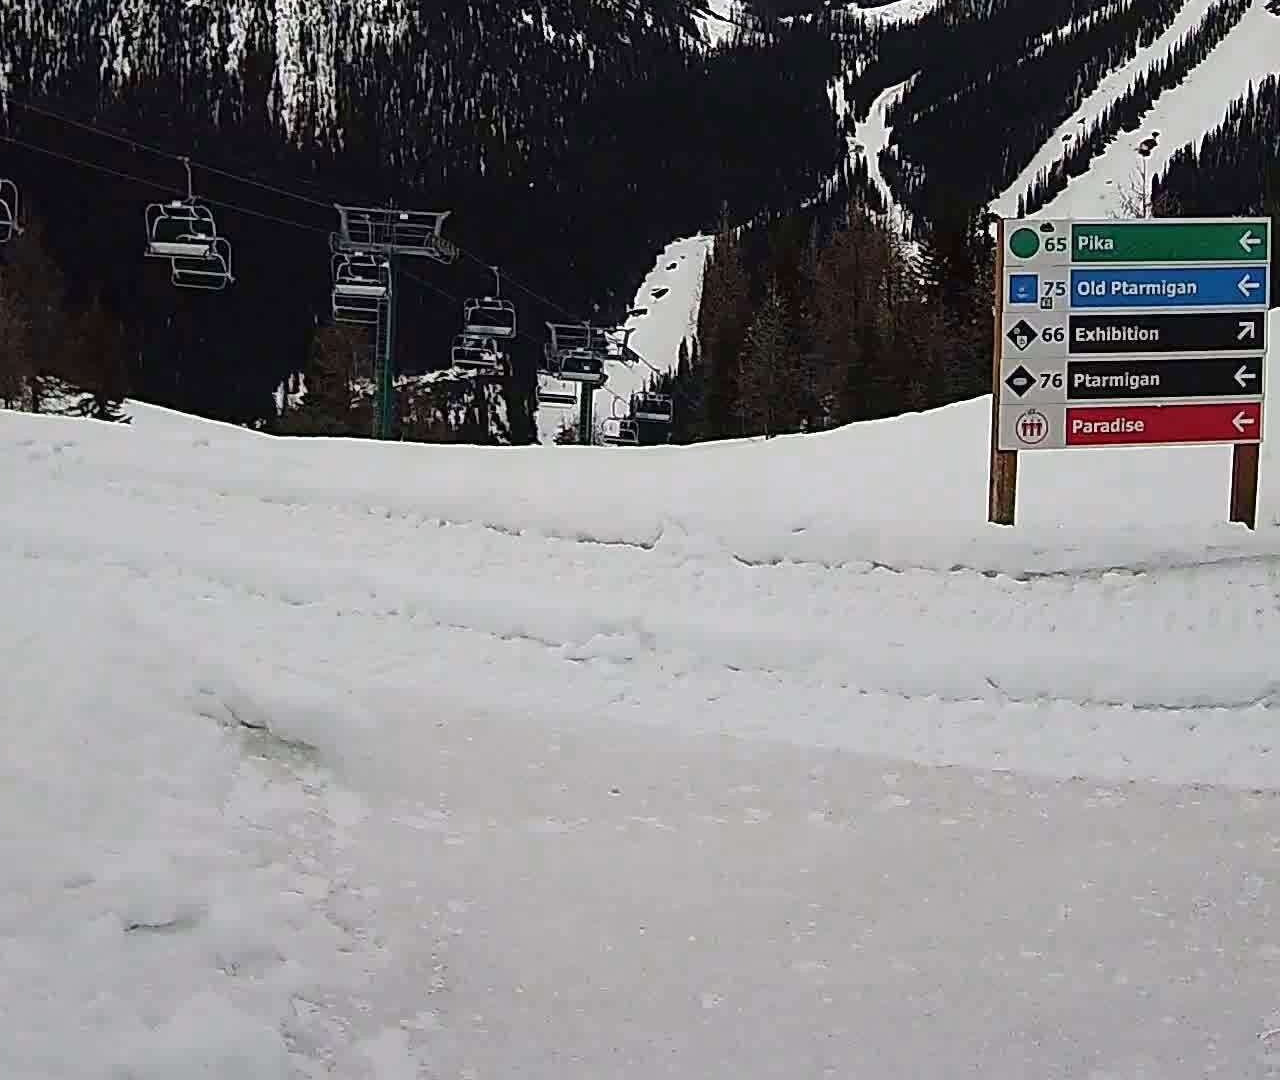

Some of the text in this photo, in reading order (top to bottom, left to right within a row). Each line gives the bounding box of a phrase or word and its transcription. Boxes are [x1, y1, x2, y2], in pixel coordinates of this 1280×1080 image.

[1044, 235, 1114, 253] 65 Pika
[1043, 280, 1198, 297] 75 Old Ptarmigan
[1041, 326, 1160, 342] 66 Exhibition
[1039, 372, 1161, 389] 76 Ptarmigan
[1071, 418, 1145, 434] Paradise
